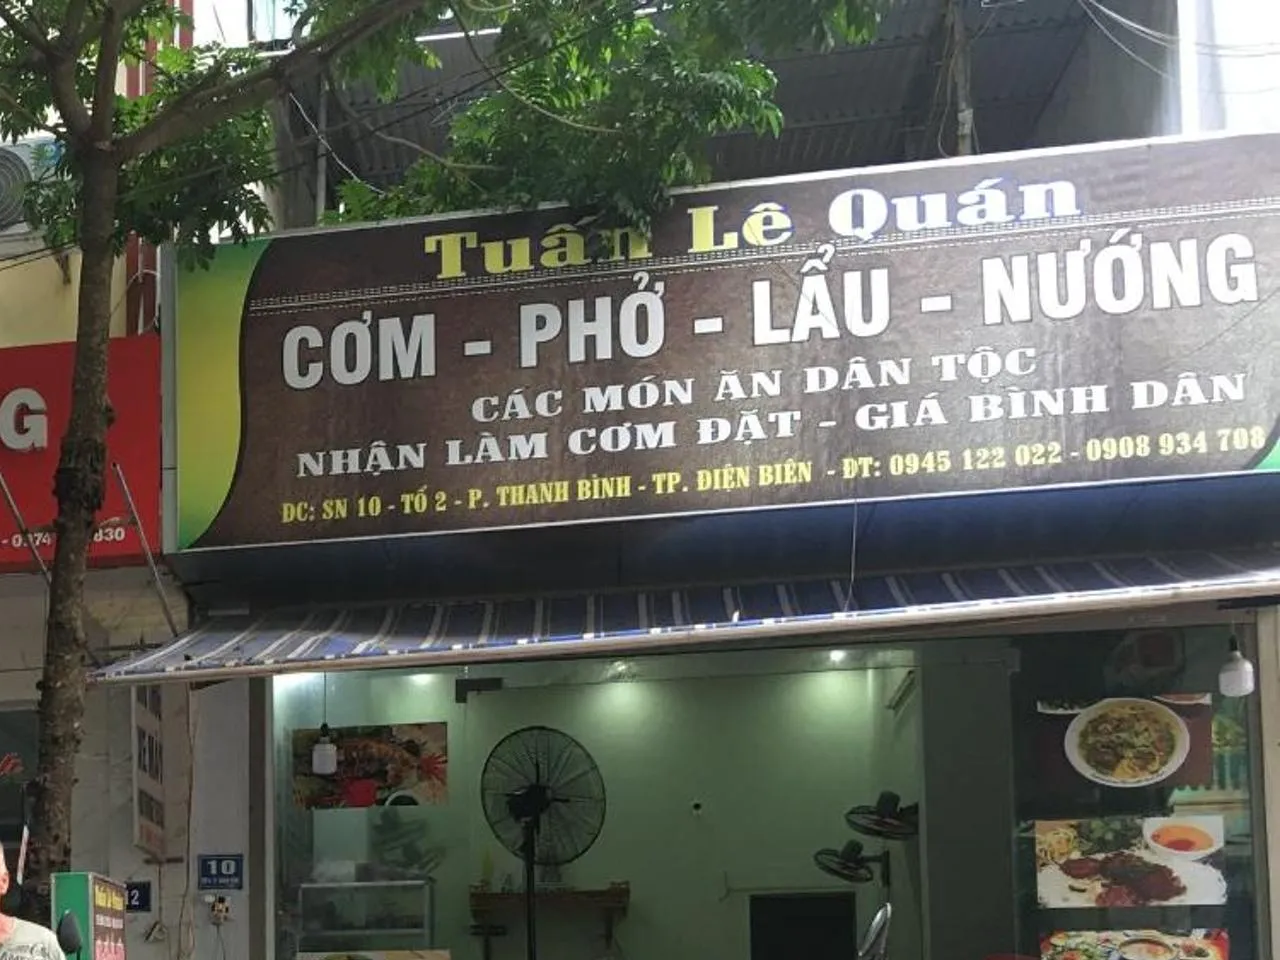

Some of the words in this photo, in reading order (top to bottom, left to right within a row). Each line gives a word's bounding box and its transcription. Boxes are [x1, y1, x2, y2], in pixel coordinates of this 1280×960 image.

[687, 203, 794, 254] Lê
[829, 177, 1081, 242] Quán
[282, 310, 436, 391] CƠM
[464, 340, 492, 357] -
[520, 271, 666, 369] PHỞ
[693, 317, 724, 335] -
[752, 245, 891, 346] LẨU
[920, 295, 952, 312] -
[982, 229, 1259, 326] NƯỚNG
[471, 384, 563, 424] CÁC
[583, 375, 696, 411] MÓN
[716, 369, 783, 400] ĂN
[805, 356, 911, 393] DÂN
[932, 346, 1037, 384] TỘC
[297, 440, 427, 479] NHẬN
[446, 431, 549, 466] LÀM
[568, 420, 678, 457] CƠM
[697, 410, 801, 445] ĐẶT
[819, 421, 837, 429] -
[854, 392, 949, 432] GIÁ
[968, 382, 1109, 423] BÌNH
[1131, 371, 1247, 411] DÂN
[322, 497, 348, 520] SN
[357, 495, 382, 519] 10
[434, 492, 448, 512] 2
[468, 487, 491, 509] P.
[496, 481, 570, 508] THANH
[577, 474, 632, 502] BÌNH
[652, 471, 689, 495] TP.
[697, 464, 749, 493] ĐIỆN
[758, 458, 813, 485] BIÊN
[841, 455, 881, 480] ĐT:
[889, 450, 951, 477] 0945
[962, 444, 1006, 471] 122
[1014, 441, 1063, 468] 022
[1086, 434, 1150, 462] 0908
[1158, 431, 1208, 457] 934
[11, 531, 52, 547] 074
[207, 859, 236, 875] 10
